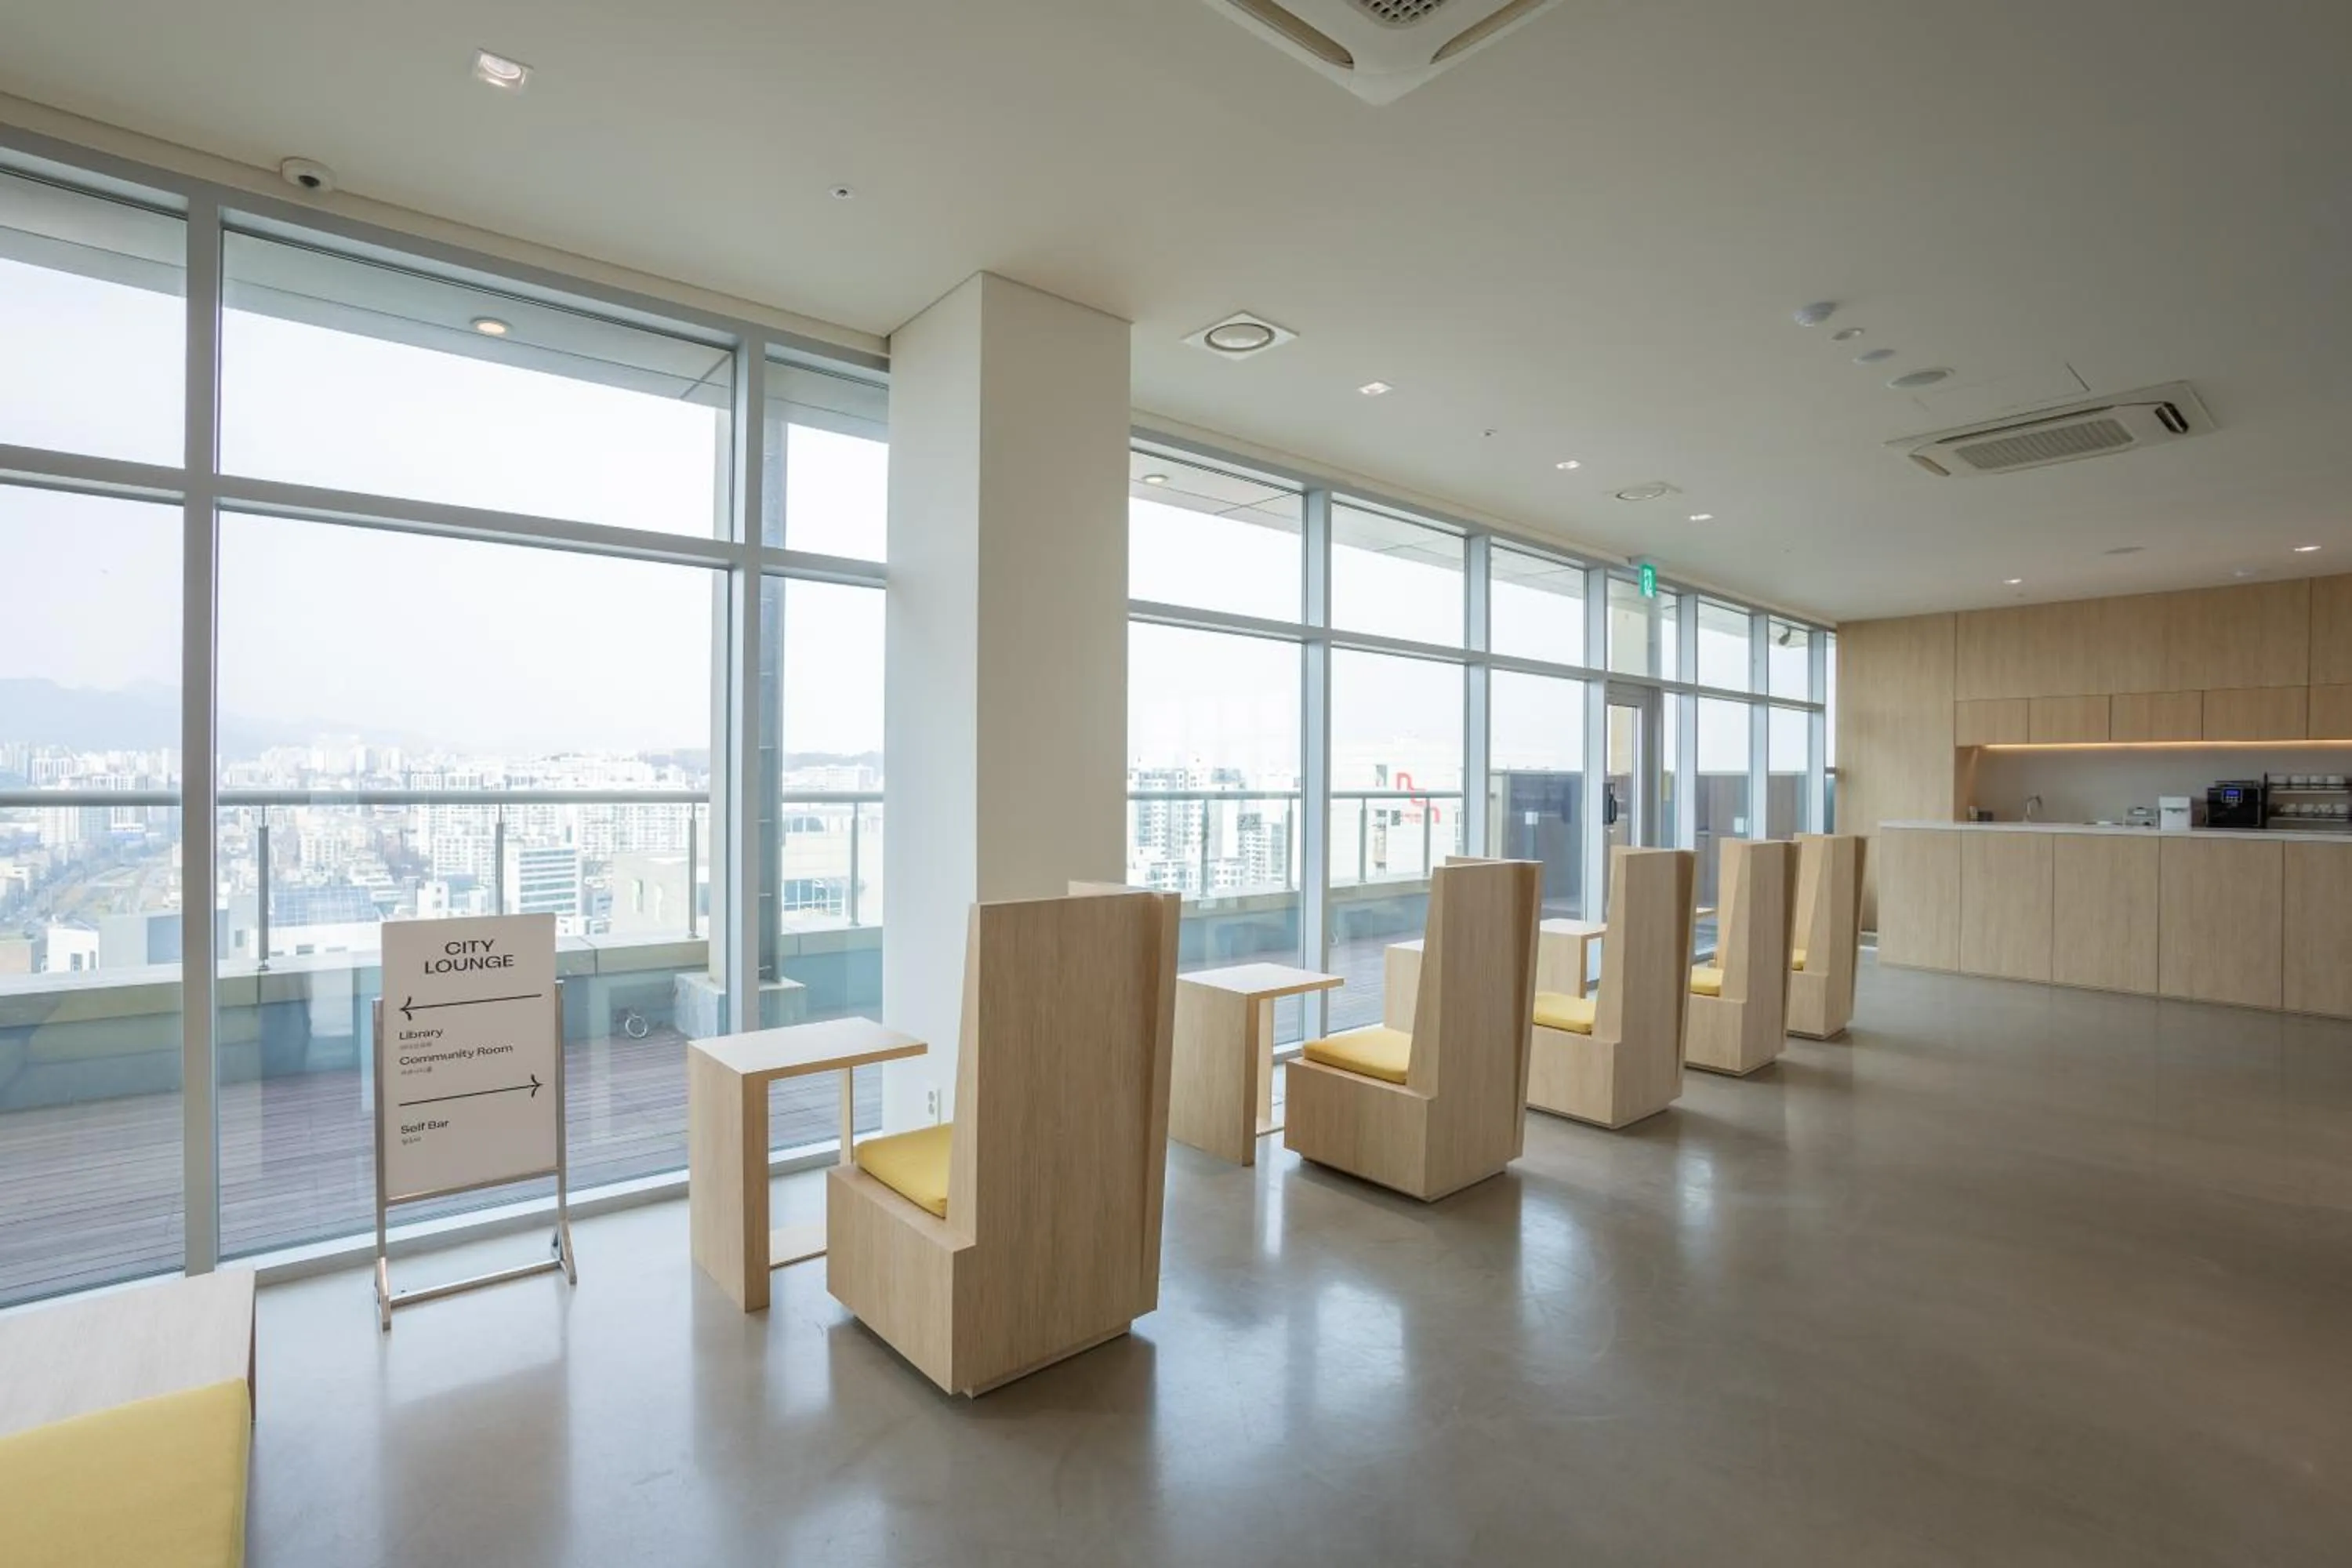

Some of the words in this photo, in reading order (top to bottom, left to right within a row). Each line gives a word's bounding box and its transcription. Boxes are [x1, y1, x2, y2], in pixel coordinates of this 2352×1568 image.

[445, 938, 495, 956] CITY
[424, 954, 514, 975] LOUNGE
[399, 1028, 444, 1040] Library
[399, 1048, 474, 1065] Community
[477, 1044, 514, 1056] Room
[401, 1122, 425, 1134] Self
[427, 1120, 449, 1130] Bar
